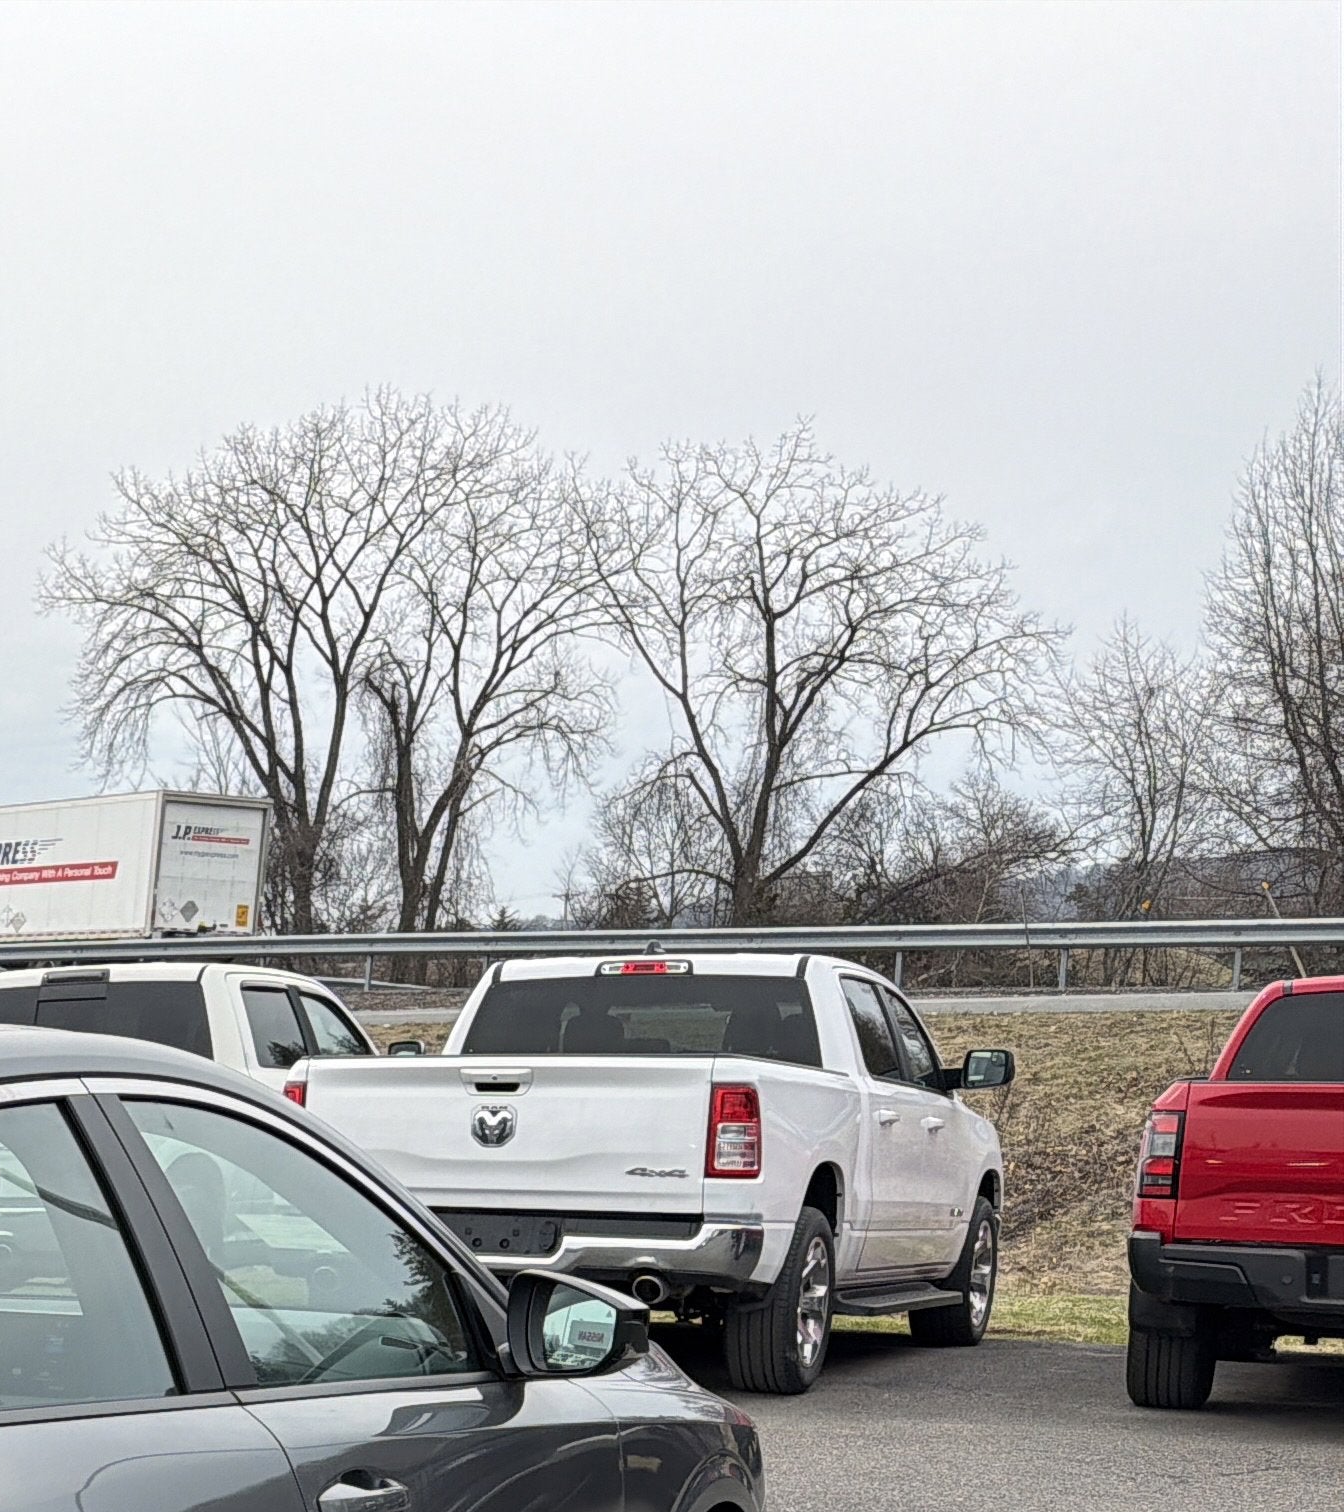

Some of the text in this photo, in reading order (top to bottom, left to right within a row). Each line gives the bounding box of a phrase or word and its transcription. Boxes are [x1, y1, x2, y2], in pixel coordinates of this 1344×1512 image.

[12, 870, 40, 882] Company
[41, 868, 56, 879] With
[57, 868, 63, 878] A
[64, 866, 92, 877] Personal
[93, 864, 113, 875] Touch
